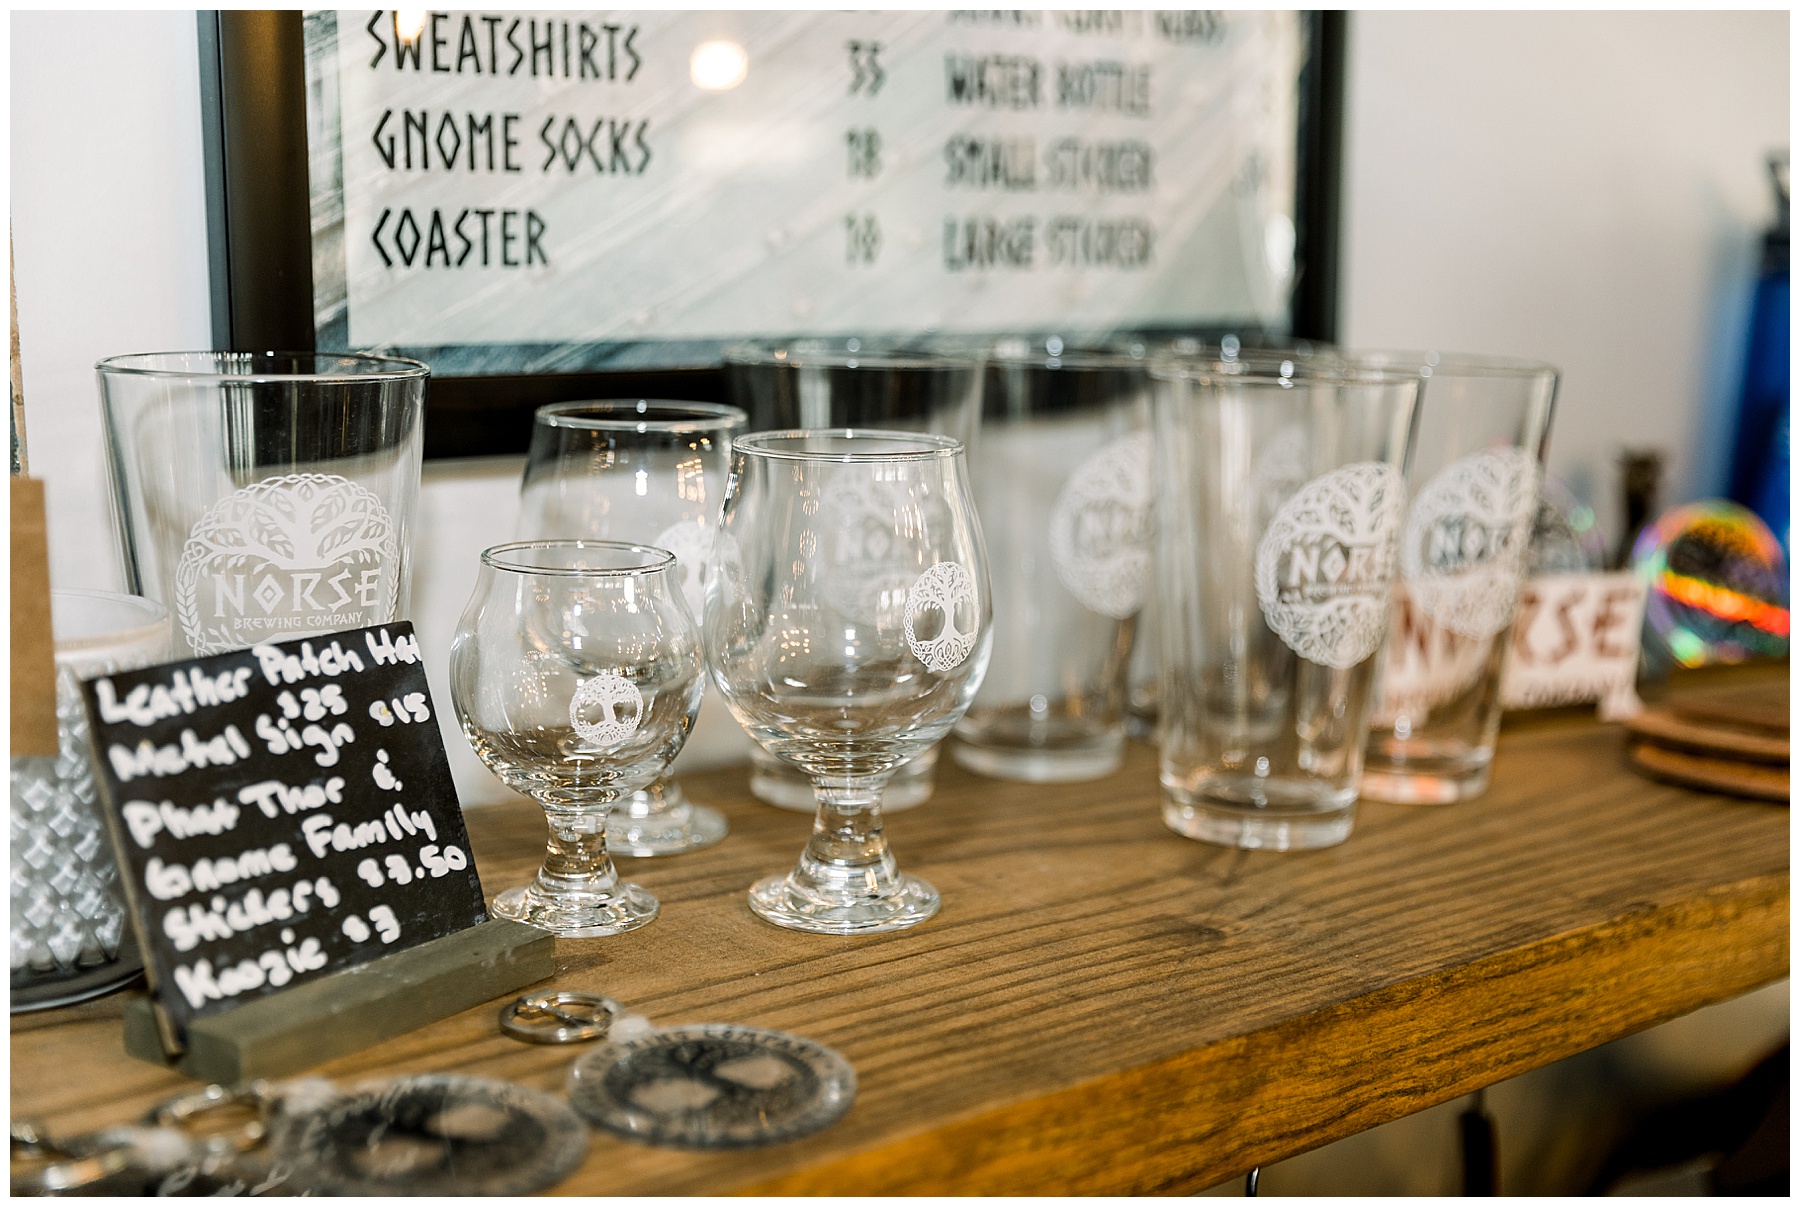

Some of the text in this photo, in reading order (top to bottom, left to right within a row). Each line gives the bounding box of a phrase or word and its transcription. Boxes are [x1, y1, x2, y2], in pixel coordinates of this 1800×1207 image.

[367, 10, 643, 81] SWEATSHIRTS
[945, 51, 1152, 119] WATER BOTTLE
[373, 109, 883, 183] GNOME SOCKS 18
[943, 134, 1155, 190] SMALL STICKER
[370, 208, 549, 269] COASTER
[943, 216, 1155, 271] LARGE STICKER
[211, 568, 382, 618] NORSE
[233, 611, 364, 631] BREWING COMPANY
[96, 666, 253, 727] Leather
[252, 641, 365, 687] Patch
[108, 724, 251, 783] Metal
[255, 713, 356, 768] Sign
[123, 798, 241, 850] Phat
[237, 776, 346, 819] Thor
[145, 802, 438, 900] Gnome Family
[162, 876, 341, 952] Stickers
[173, 926, 328, 1010] Koozie
